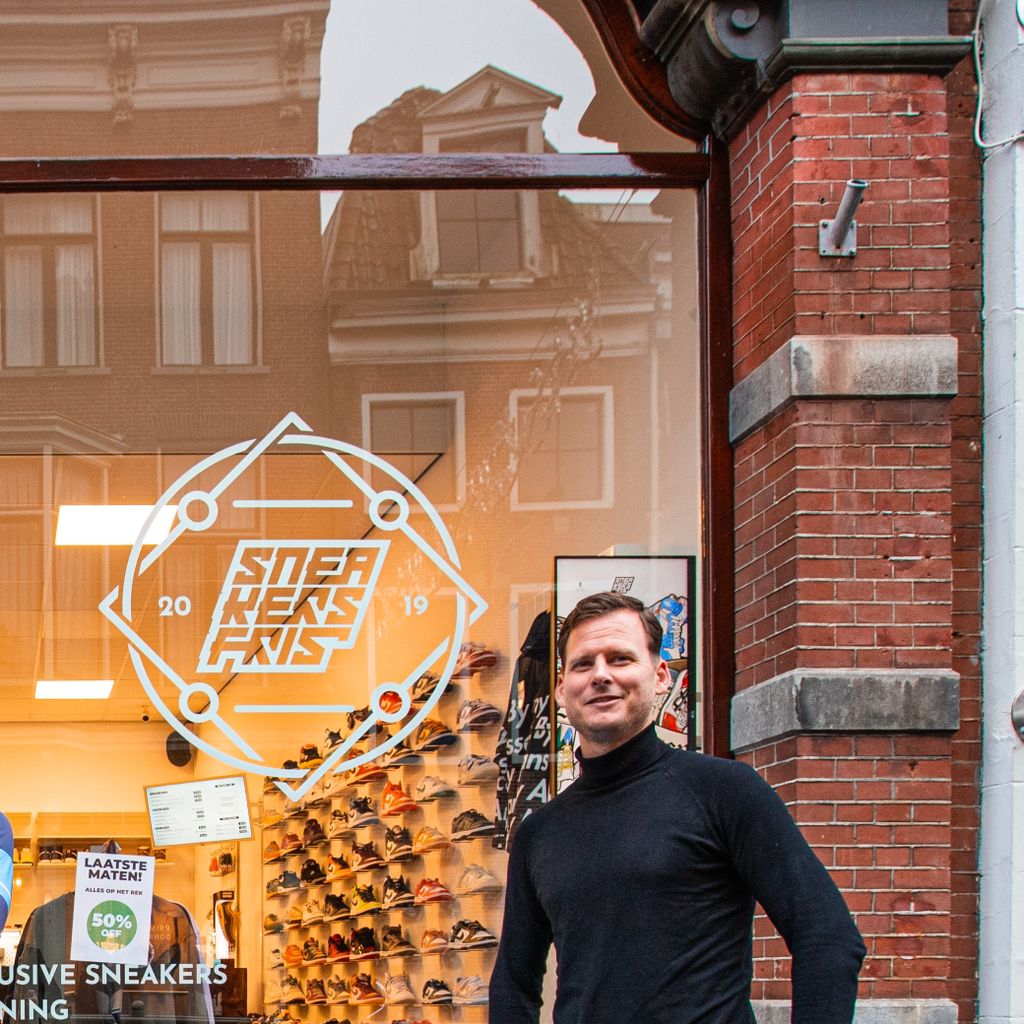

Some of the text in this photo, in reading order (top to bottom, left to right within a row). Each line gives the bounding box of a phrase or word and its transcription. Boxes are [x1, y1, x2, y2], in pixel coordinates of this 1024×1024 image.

[158, 596, 429, 617] 20 19
[84, 857, 148, 871] LAATSTE
[87, 868, 143, 882] MATEN!
[91, 912, 133, 930] 50%
[100, 929, 122, 938] OFF
[85, 963, 228, 986] SNEAKERS
